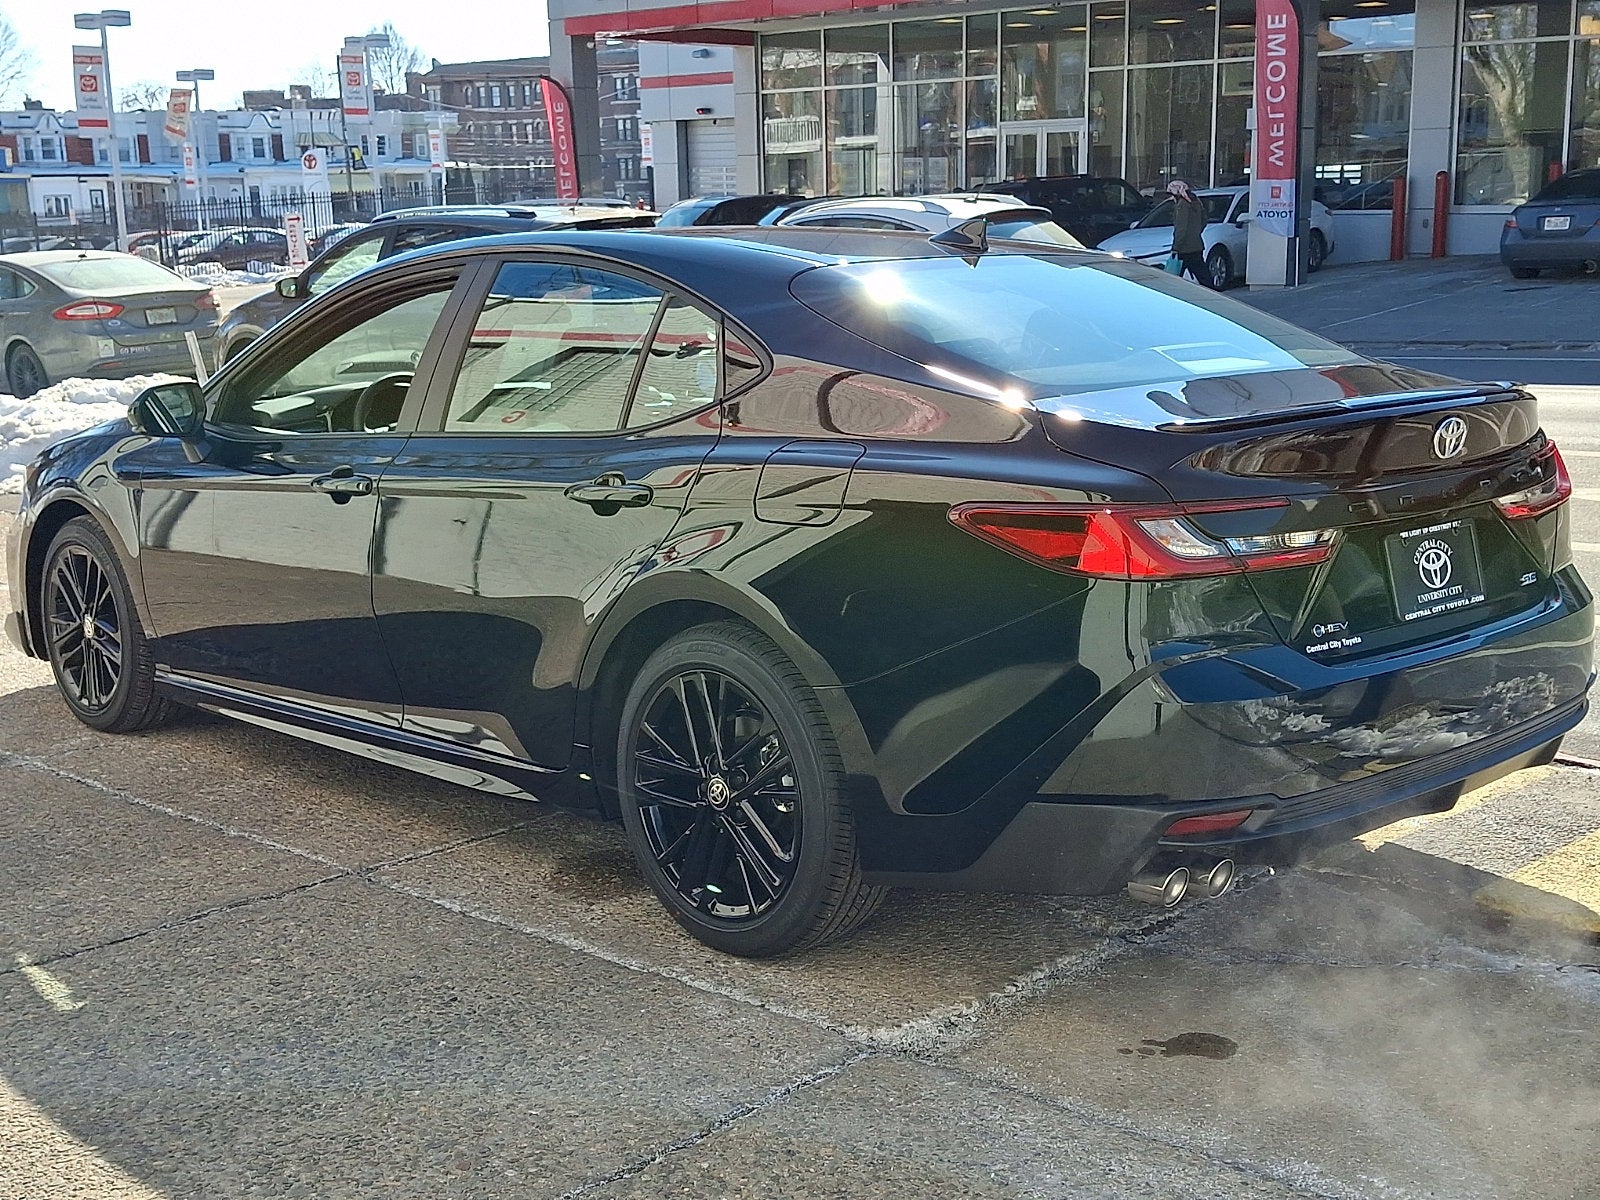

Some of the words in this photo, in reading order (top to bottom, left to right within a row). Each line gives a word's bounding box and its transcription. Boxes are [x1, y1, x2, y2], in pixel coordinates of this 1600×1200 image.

[1413, 539, 1437, 565] CENTRAL
[1437, 539, 1453, 556] CITY
[1417, 588, 1449, 603] UNIVERSITY
[1448, 584, 1463, 596] CITY
[1405, 609, 1432, 620] CENTRAL
[1432, 604, 1446, 613] CITY
[1446, 599, 1469, 610] TOYOTA
[1306, 642, 1329, 653] Central
[1329, 640, 1342, 649] City
[1342, 636, 1362, 647] Toyota
